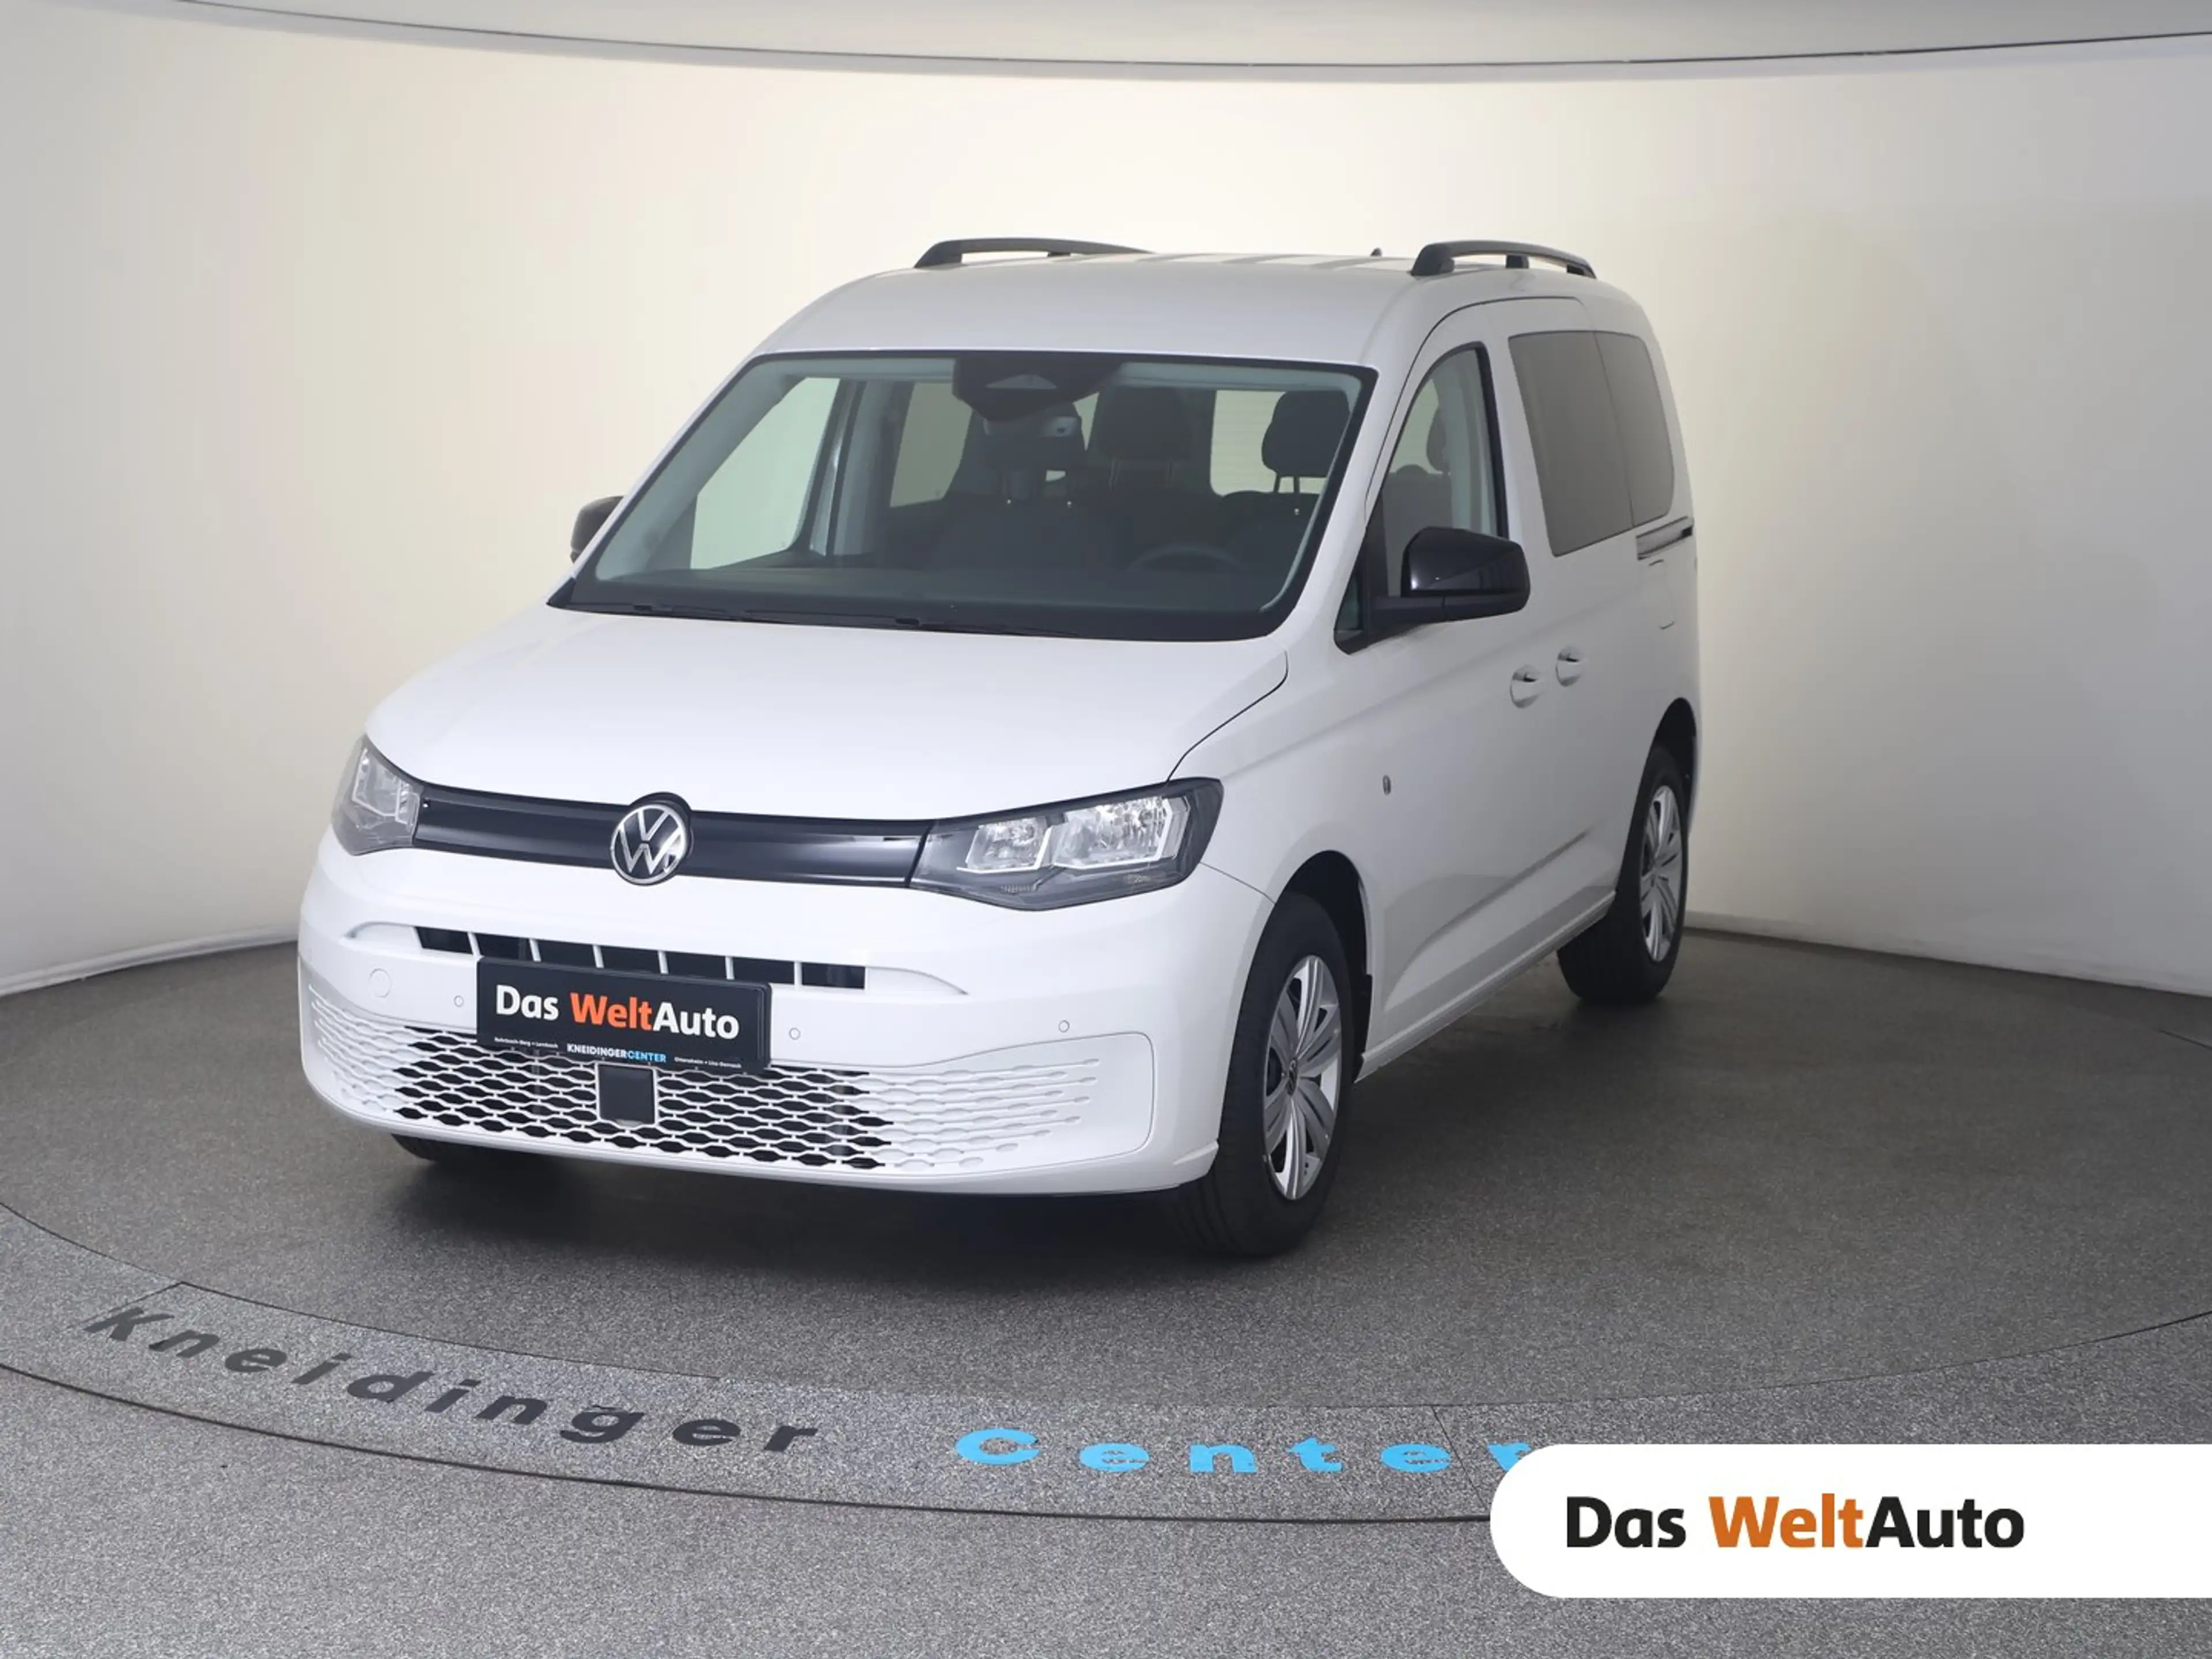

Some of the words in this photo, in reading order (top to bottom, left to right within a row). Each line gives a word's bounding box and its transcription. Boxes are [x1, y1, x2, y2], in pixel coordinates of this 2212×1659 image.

[496, 984, 559, 1021] Das
[570, 991, 740, 1040] WeltAuto
[83, 1306, 819, 1453] Kneidinger
